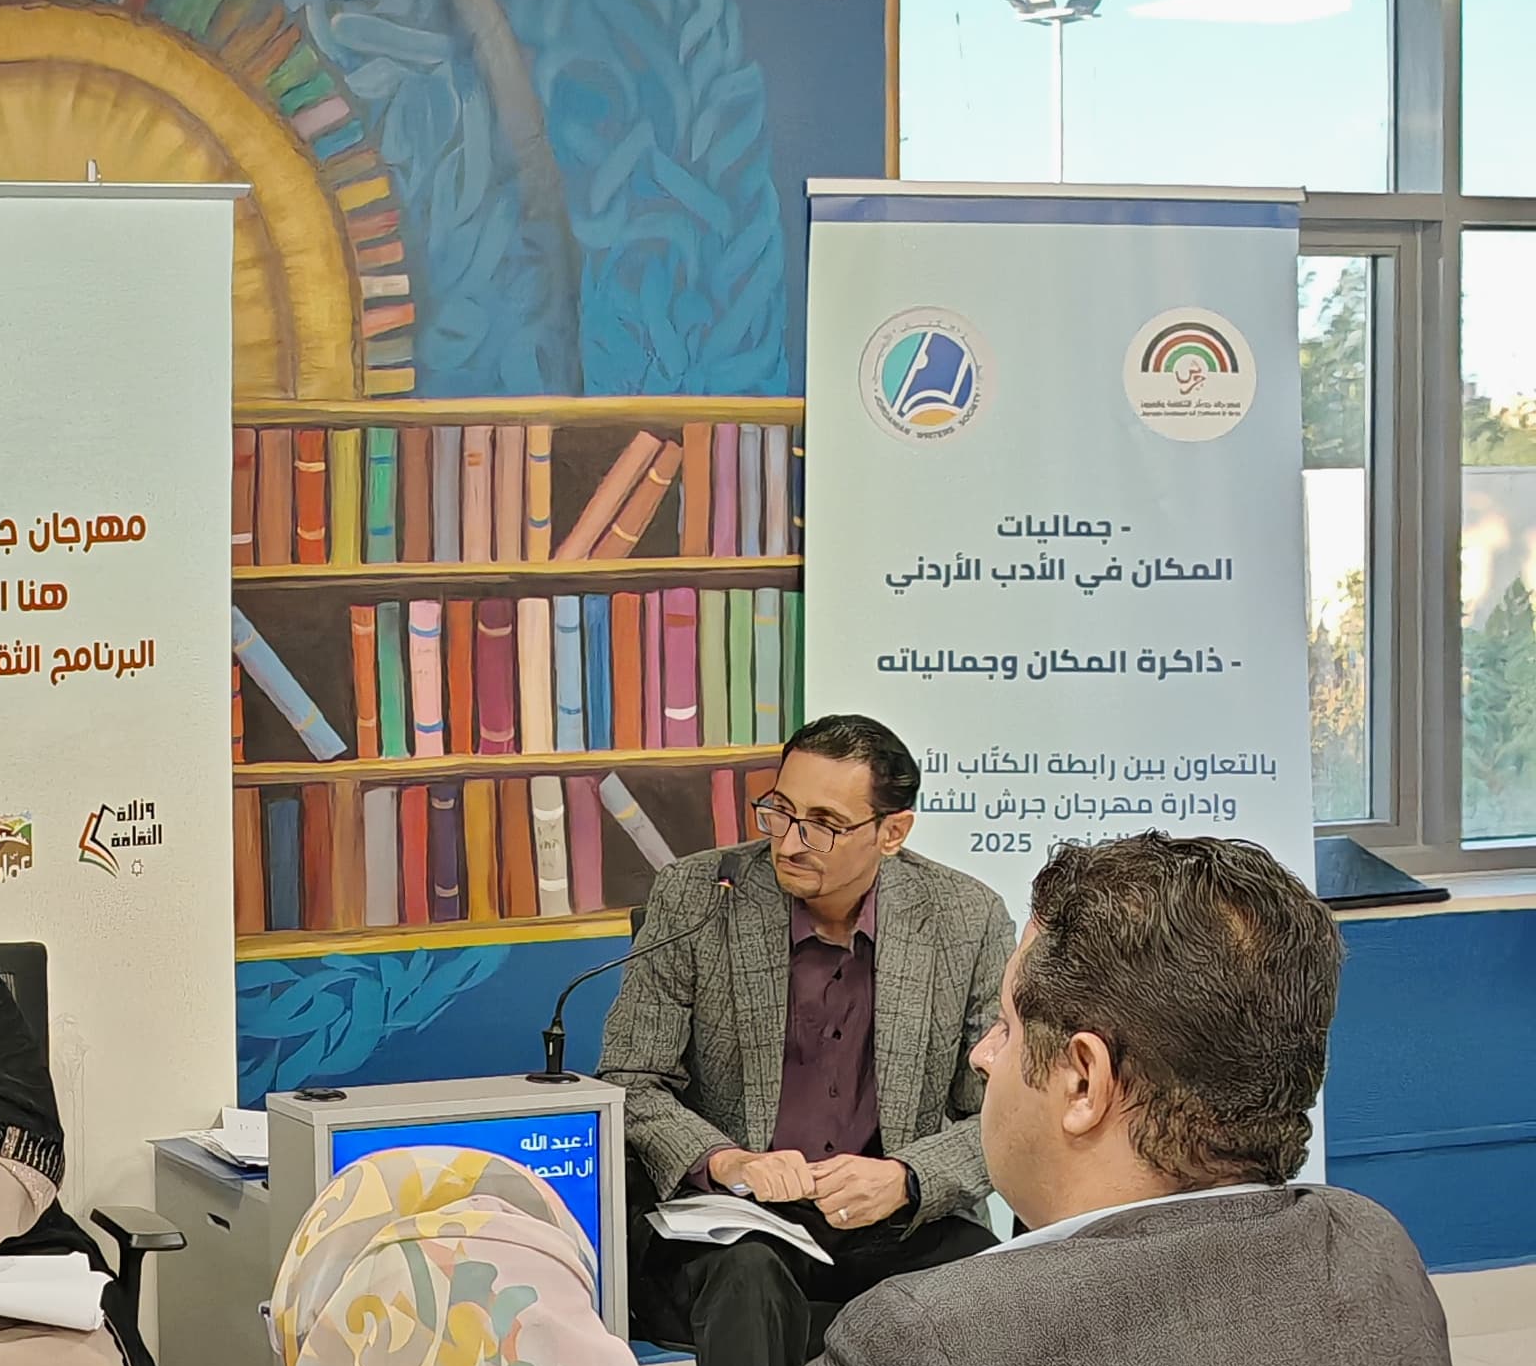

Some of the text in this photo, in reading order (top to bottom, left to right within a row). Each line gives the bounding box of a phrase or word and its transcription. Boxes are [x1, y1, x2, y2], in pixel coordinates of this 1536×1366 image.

[28, 512, 146, 555] مهرجان
[997, 513, 1113, 544] جماليات
[884, 551, 1234, 596] المكان في الأدب الأردني
[17, 580, 68, 612] هنا
[49, 640, 156, 687] البرنامج
[876, 648, 1019, 681] وجمالياته
[1027, 649, 1128, 681] المكان
[1135, 647, 1224, 681] ذاكرة
[1048, 752, 1116, 782] رابطة
[1124, 755, 1165, 781] بين
[1173, 753, 1277, 782] بالتعاون
[985, 789, 1046, 821] جرش
[1054, 793, 1153, 821] مهرجان
[1162, 793, 1237, 823] وإدارة
[111, 824, 163, 848] الثقافة
[970, 833, 1032, 853] 2025
[520, 1132, 548, 1151] الله
[550, 1136, 582, 1153] عبد
[576, 1156, 593, 1178] آل
